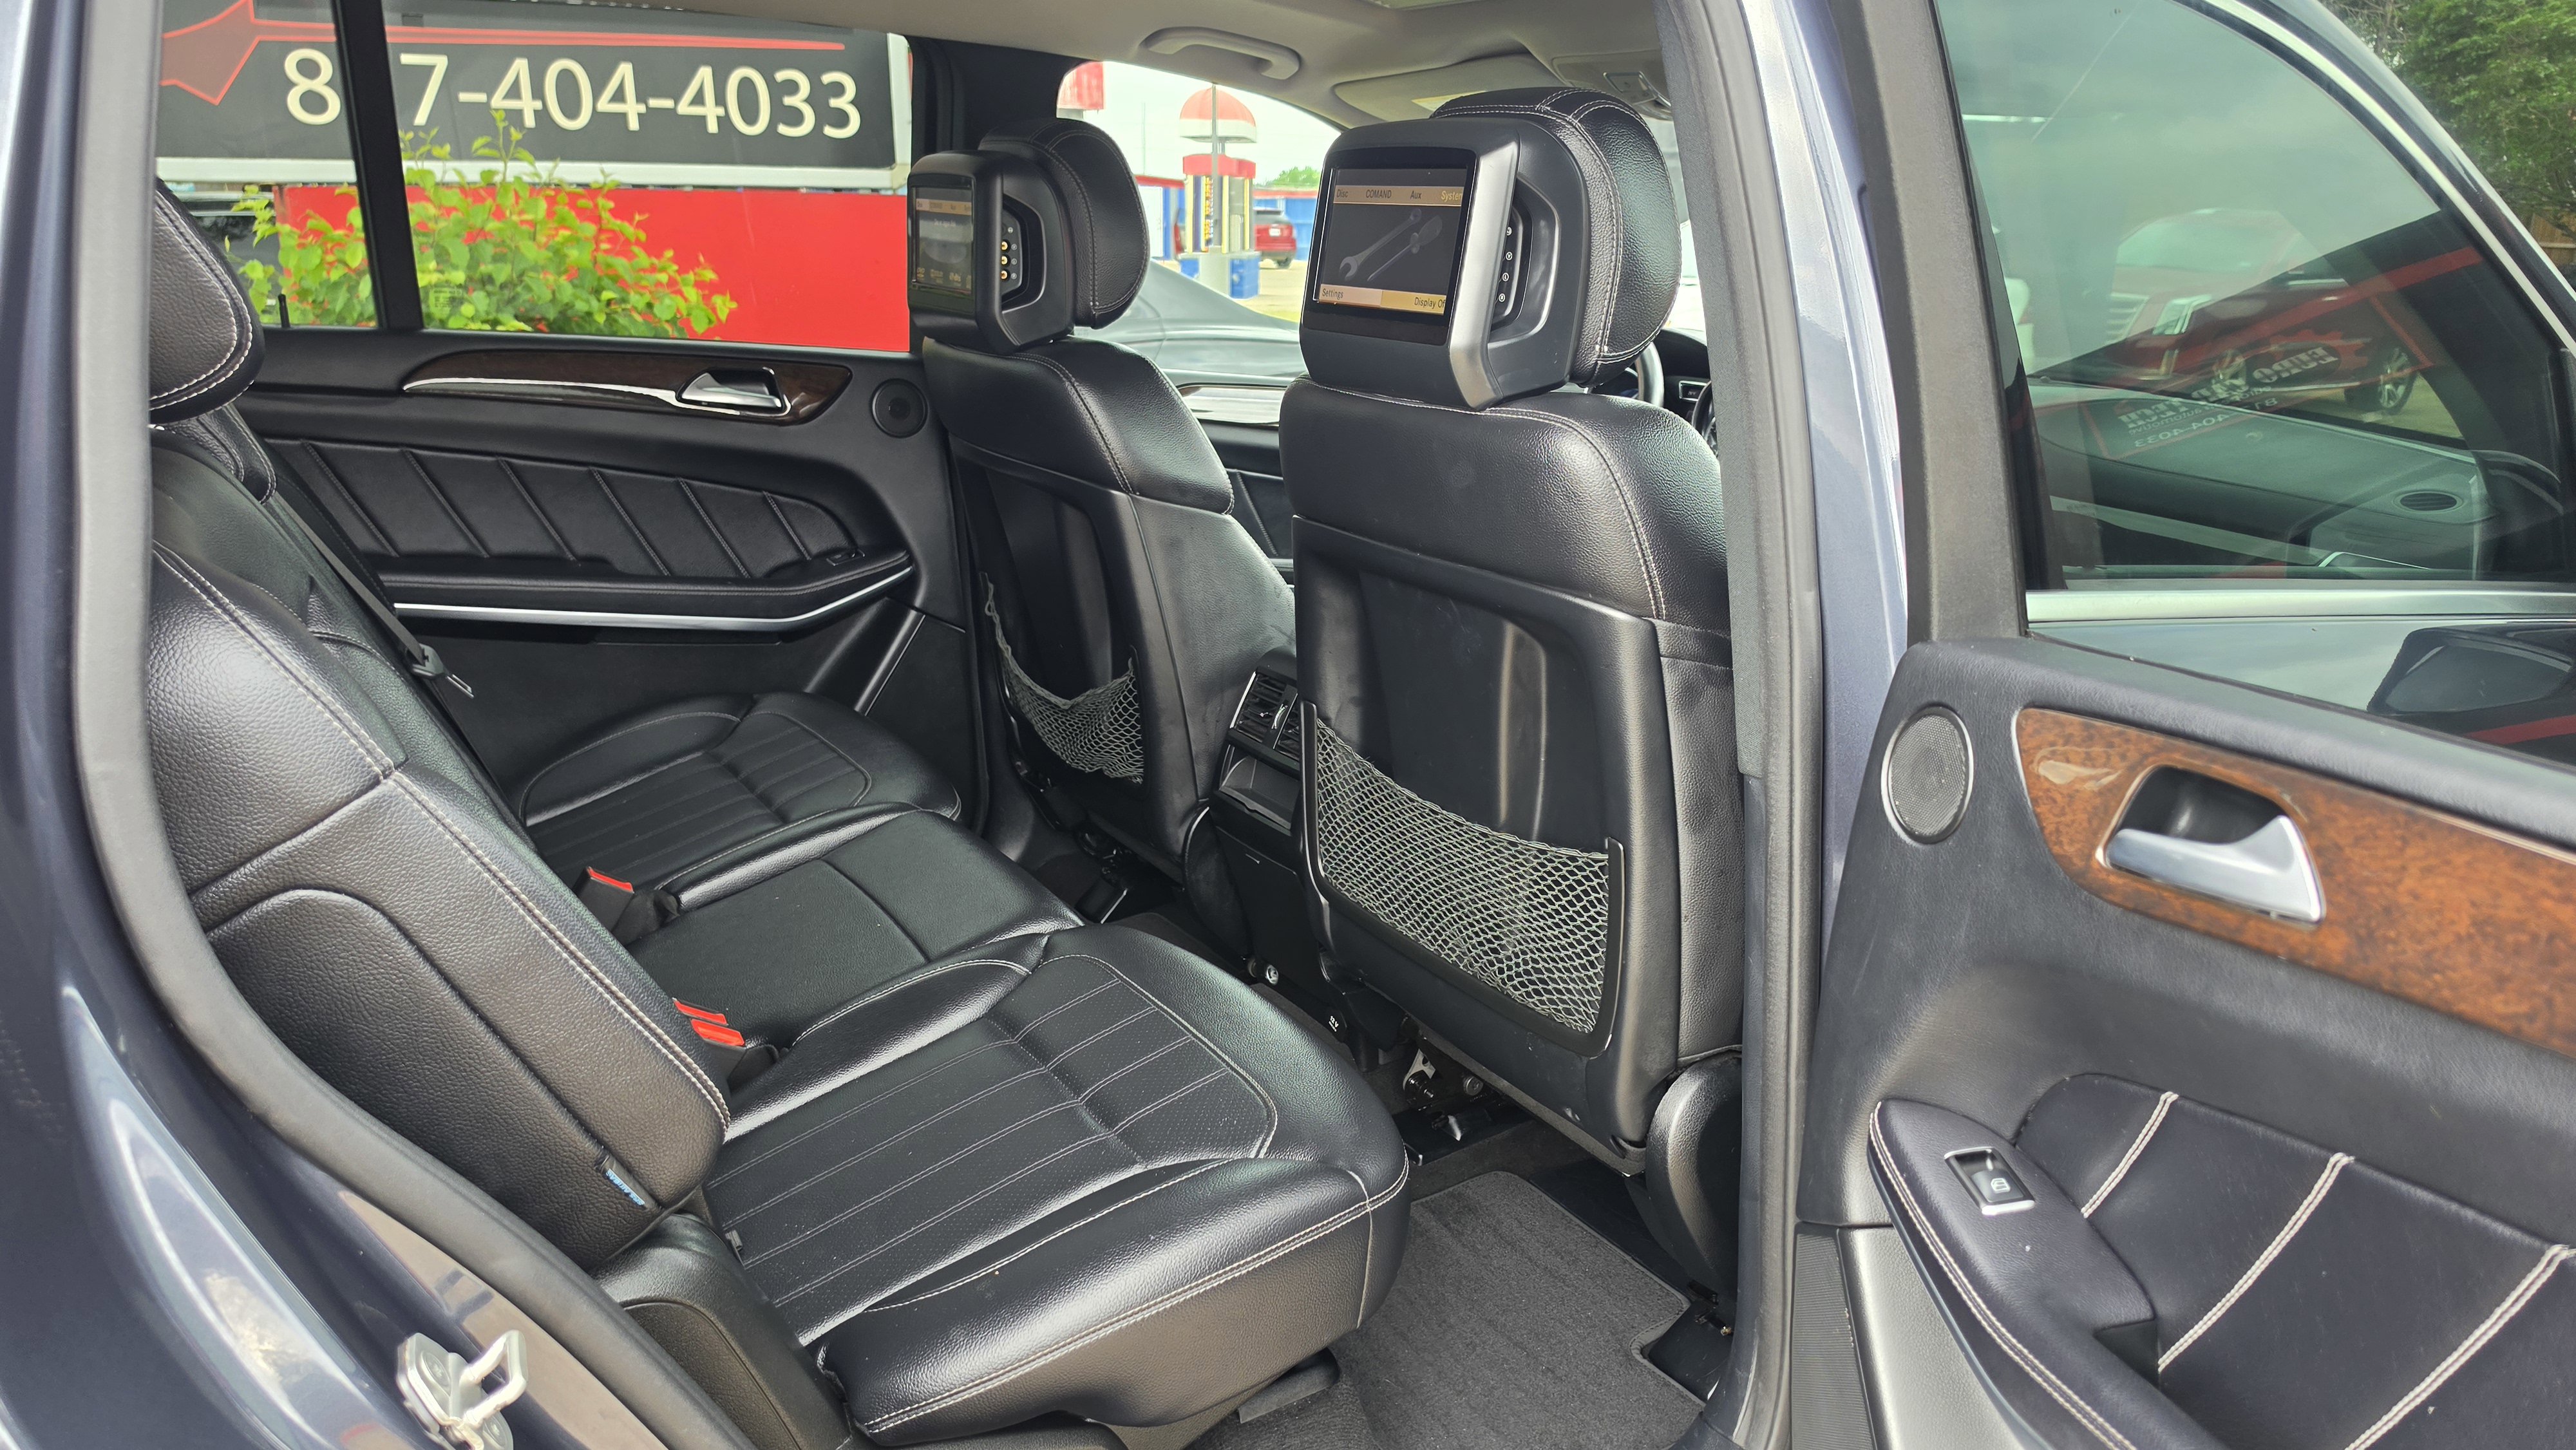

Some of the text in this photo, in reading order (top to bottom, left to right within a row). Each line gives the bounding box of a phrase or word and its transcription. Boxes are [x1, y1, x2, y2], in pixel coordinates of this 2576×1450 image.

[284, 48, 861, 139] 87-404-4033
[1336, 189, 1348, 198] Disc
[1366, 189, 1392, 198] COMAND
[1410, 190, 1422, 199] Aux
[1322, 288, 1343, 300] Settings
[1414, 297, 1436, 309] Display
